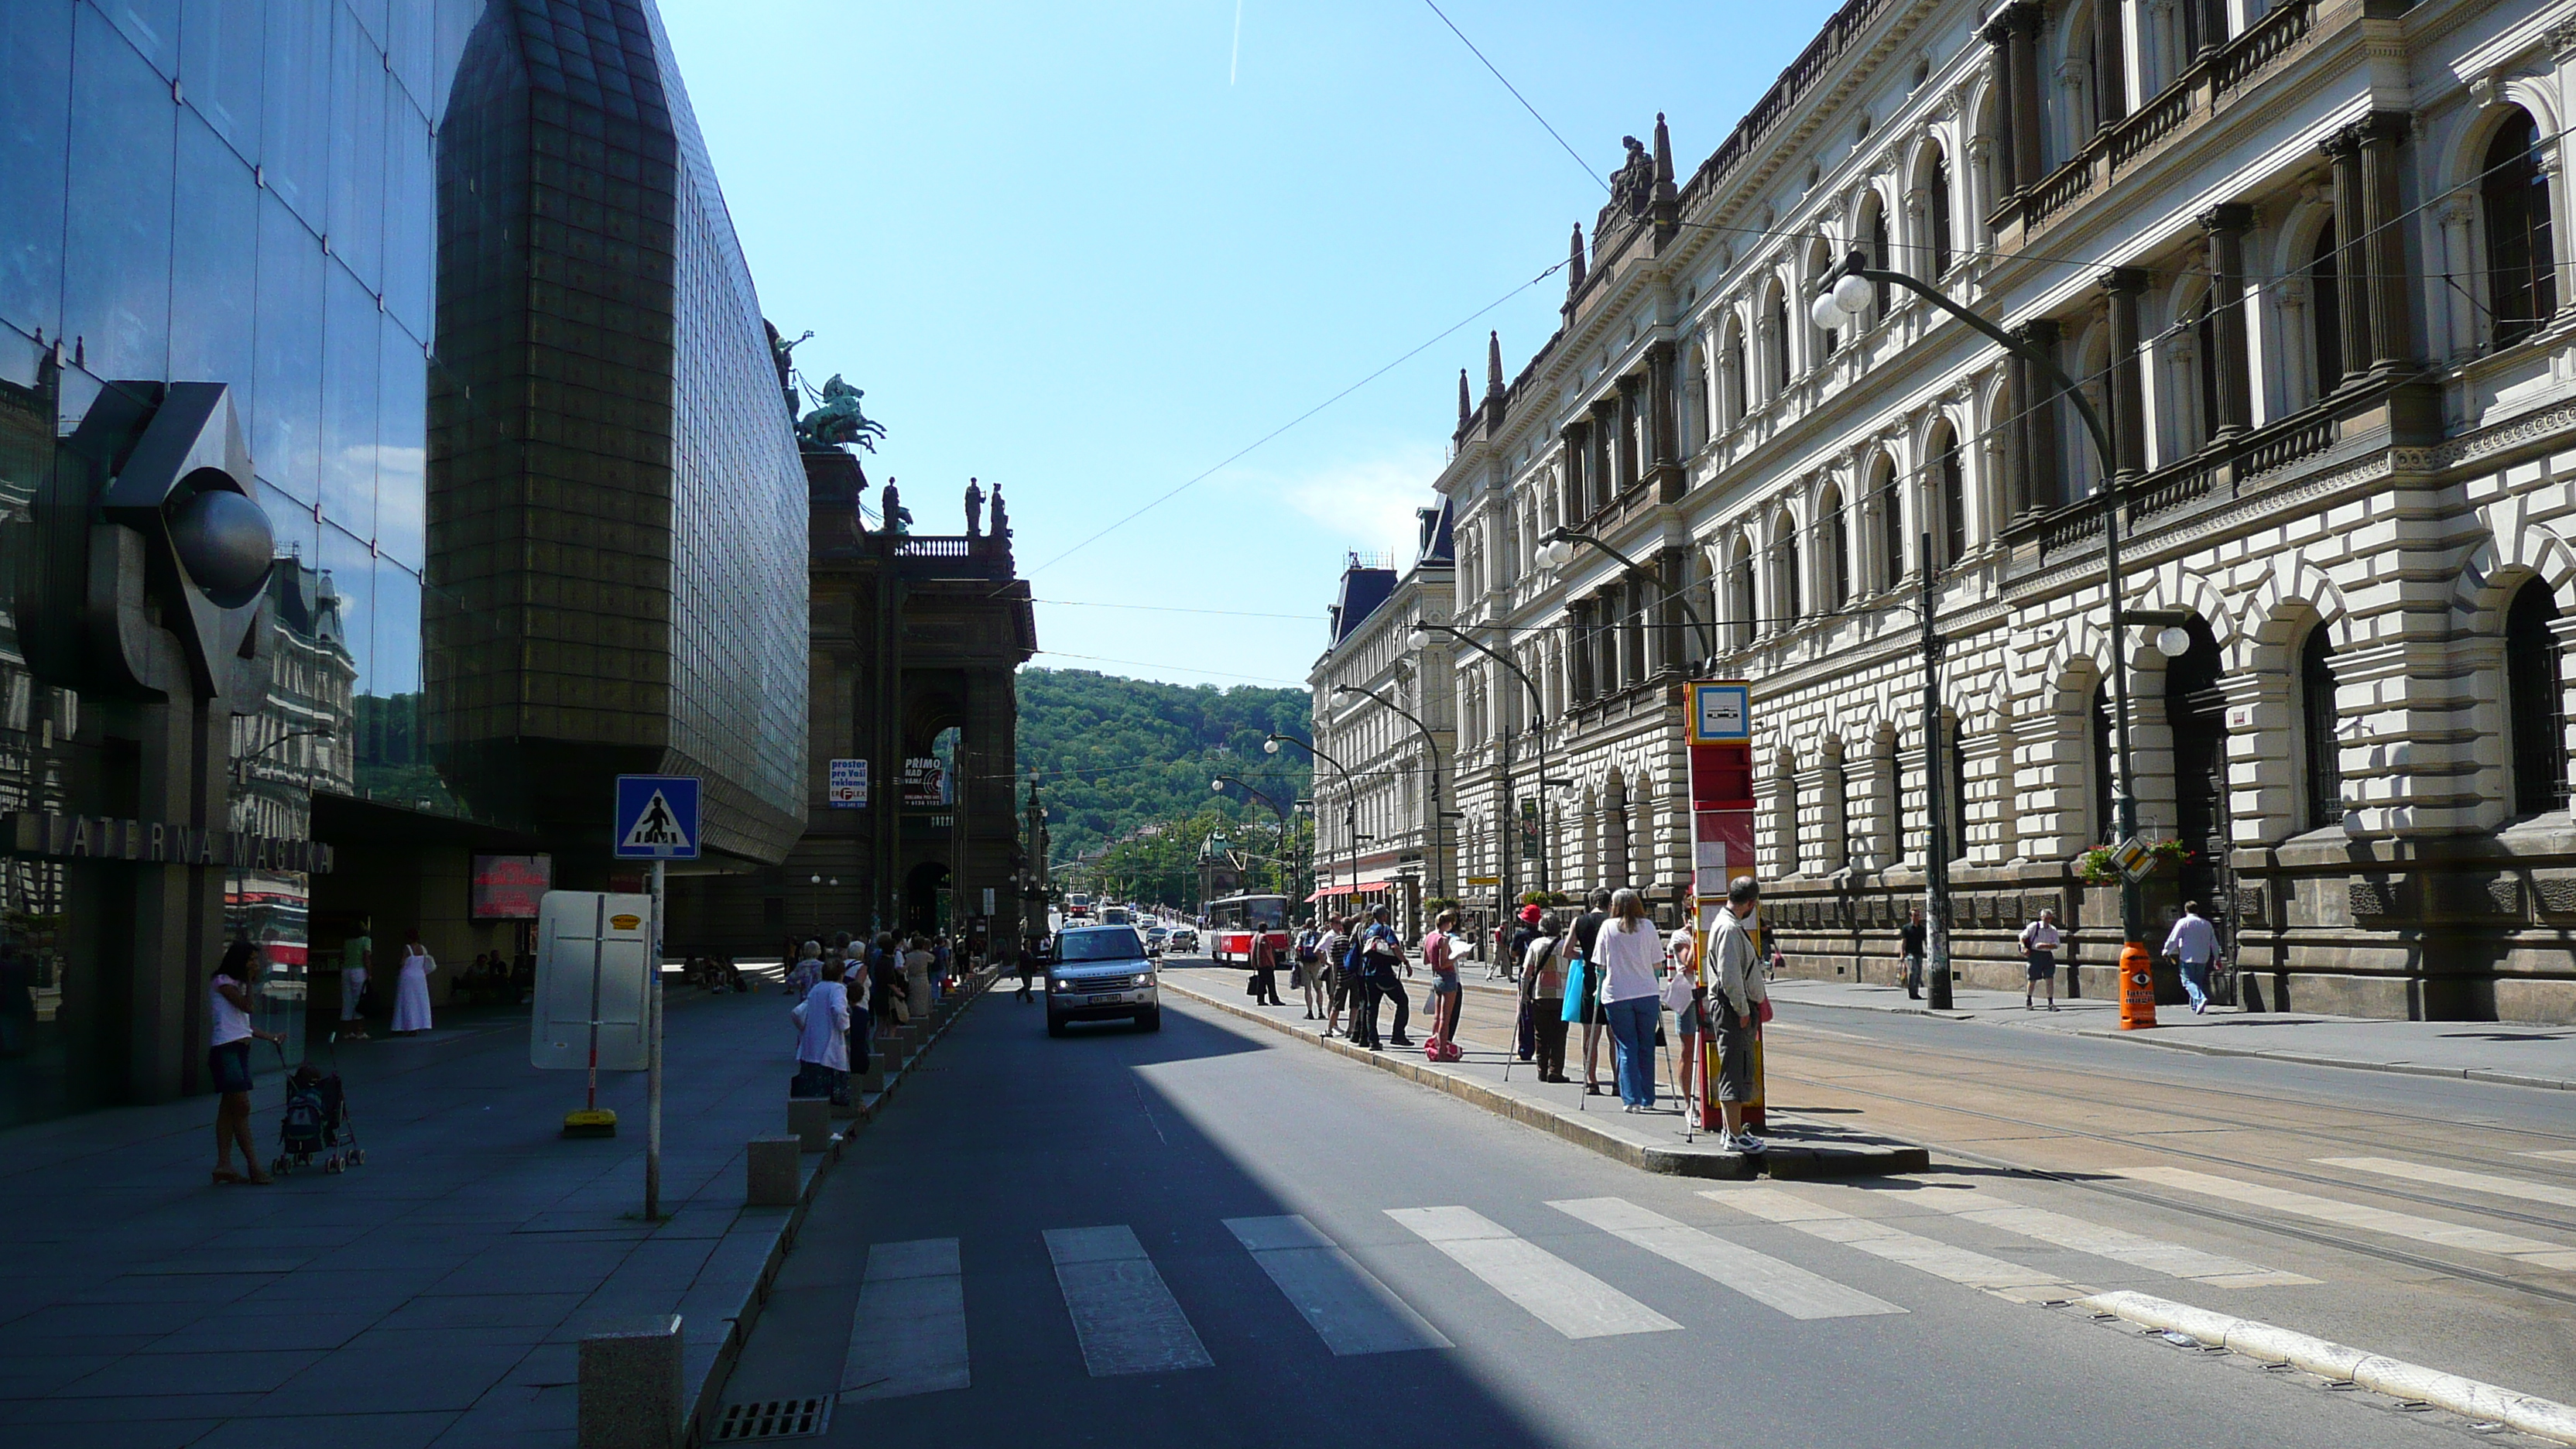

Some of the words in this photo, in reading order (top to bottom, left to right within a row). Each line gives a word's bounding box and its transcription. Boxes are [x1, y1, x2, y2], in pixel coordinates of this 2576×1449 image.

[831, 761, 866, 770] prostor
[905, 757, 941, 769] PŘÍMO
[905, 769, 923, 777] NAD
[48, 810, 213, 865] LATERNA
[232, 831, 333, 874] MAGIKA
